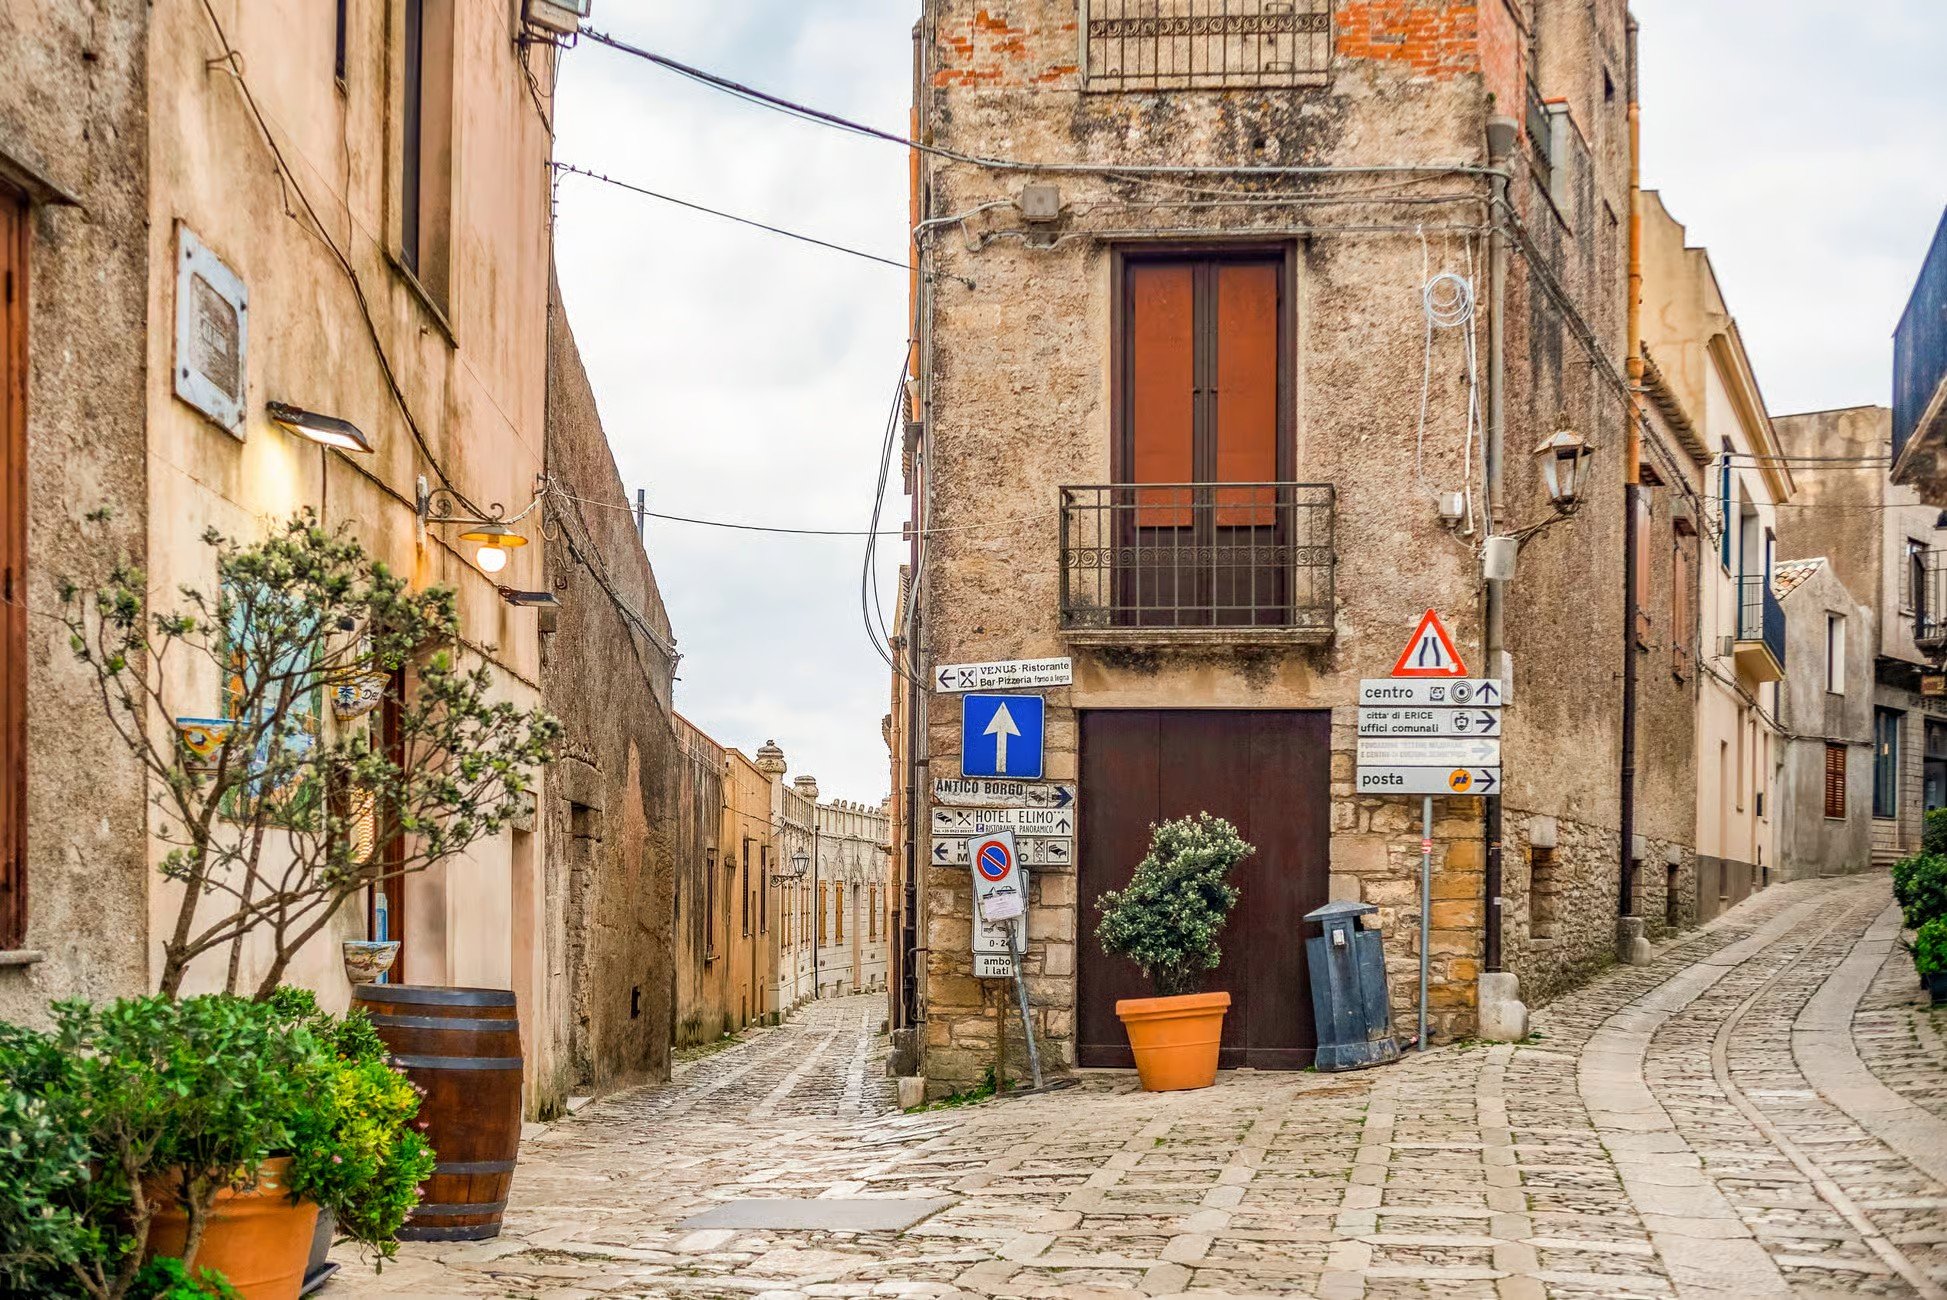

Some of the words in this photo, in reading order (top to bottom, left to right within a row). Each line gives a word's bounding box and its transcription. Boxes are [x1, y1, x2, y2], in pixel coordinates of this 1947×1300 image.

[980, 664, 1017, 675] VENUS
[1022, 662, 1069, 673] Ristorante
[1054, 674, 1069, 683] legna
[1365, 686, 1414, 698] centro
[1392, 711, 1400, 719] di
[1404, 711, 1433, 720] ERICE
[1360, 724, 1388, 733] uffici
[1392, 724, 1439, 733] comunali
[1362, 772, 1404, 787] posta
[936, 779, 979, 794] ANTICO
[984, 781, 1024, 796] BORGO
[976, 810, 1012, 823] HOTEL
[1018, 810, 1054, 824] ELIMO
[1019, 824, 1054, 834] PANORAMICO
[983, 957, 1011, 966] ambo
[992, 966, 1009, 975] lati
